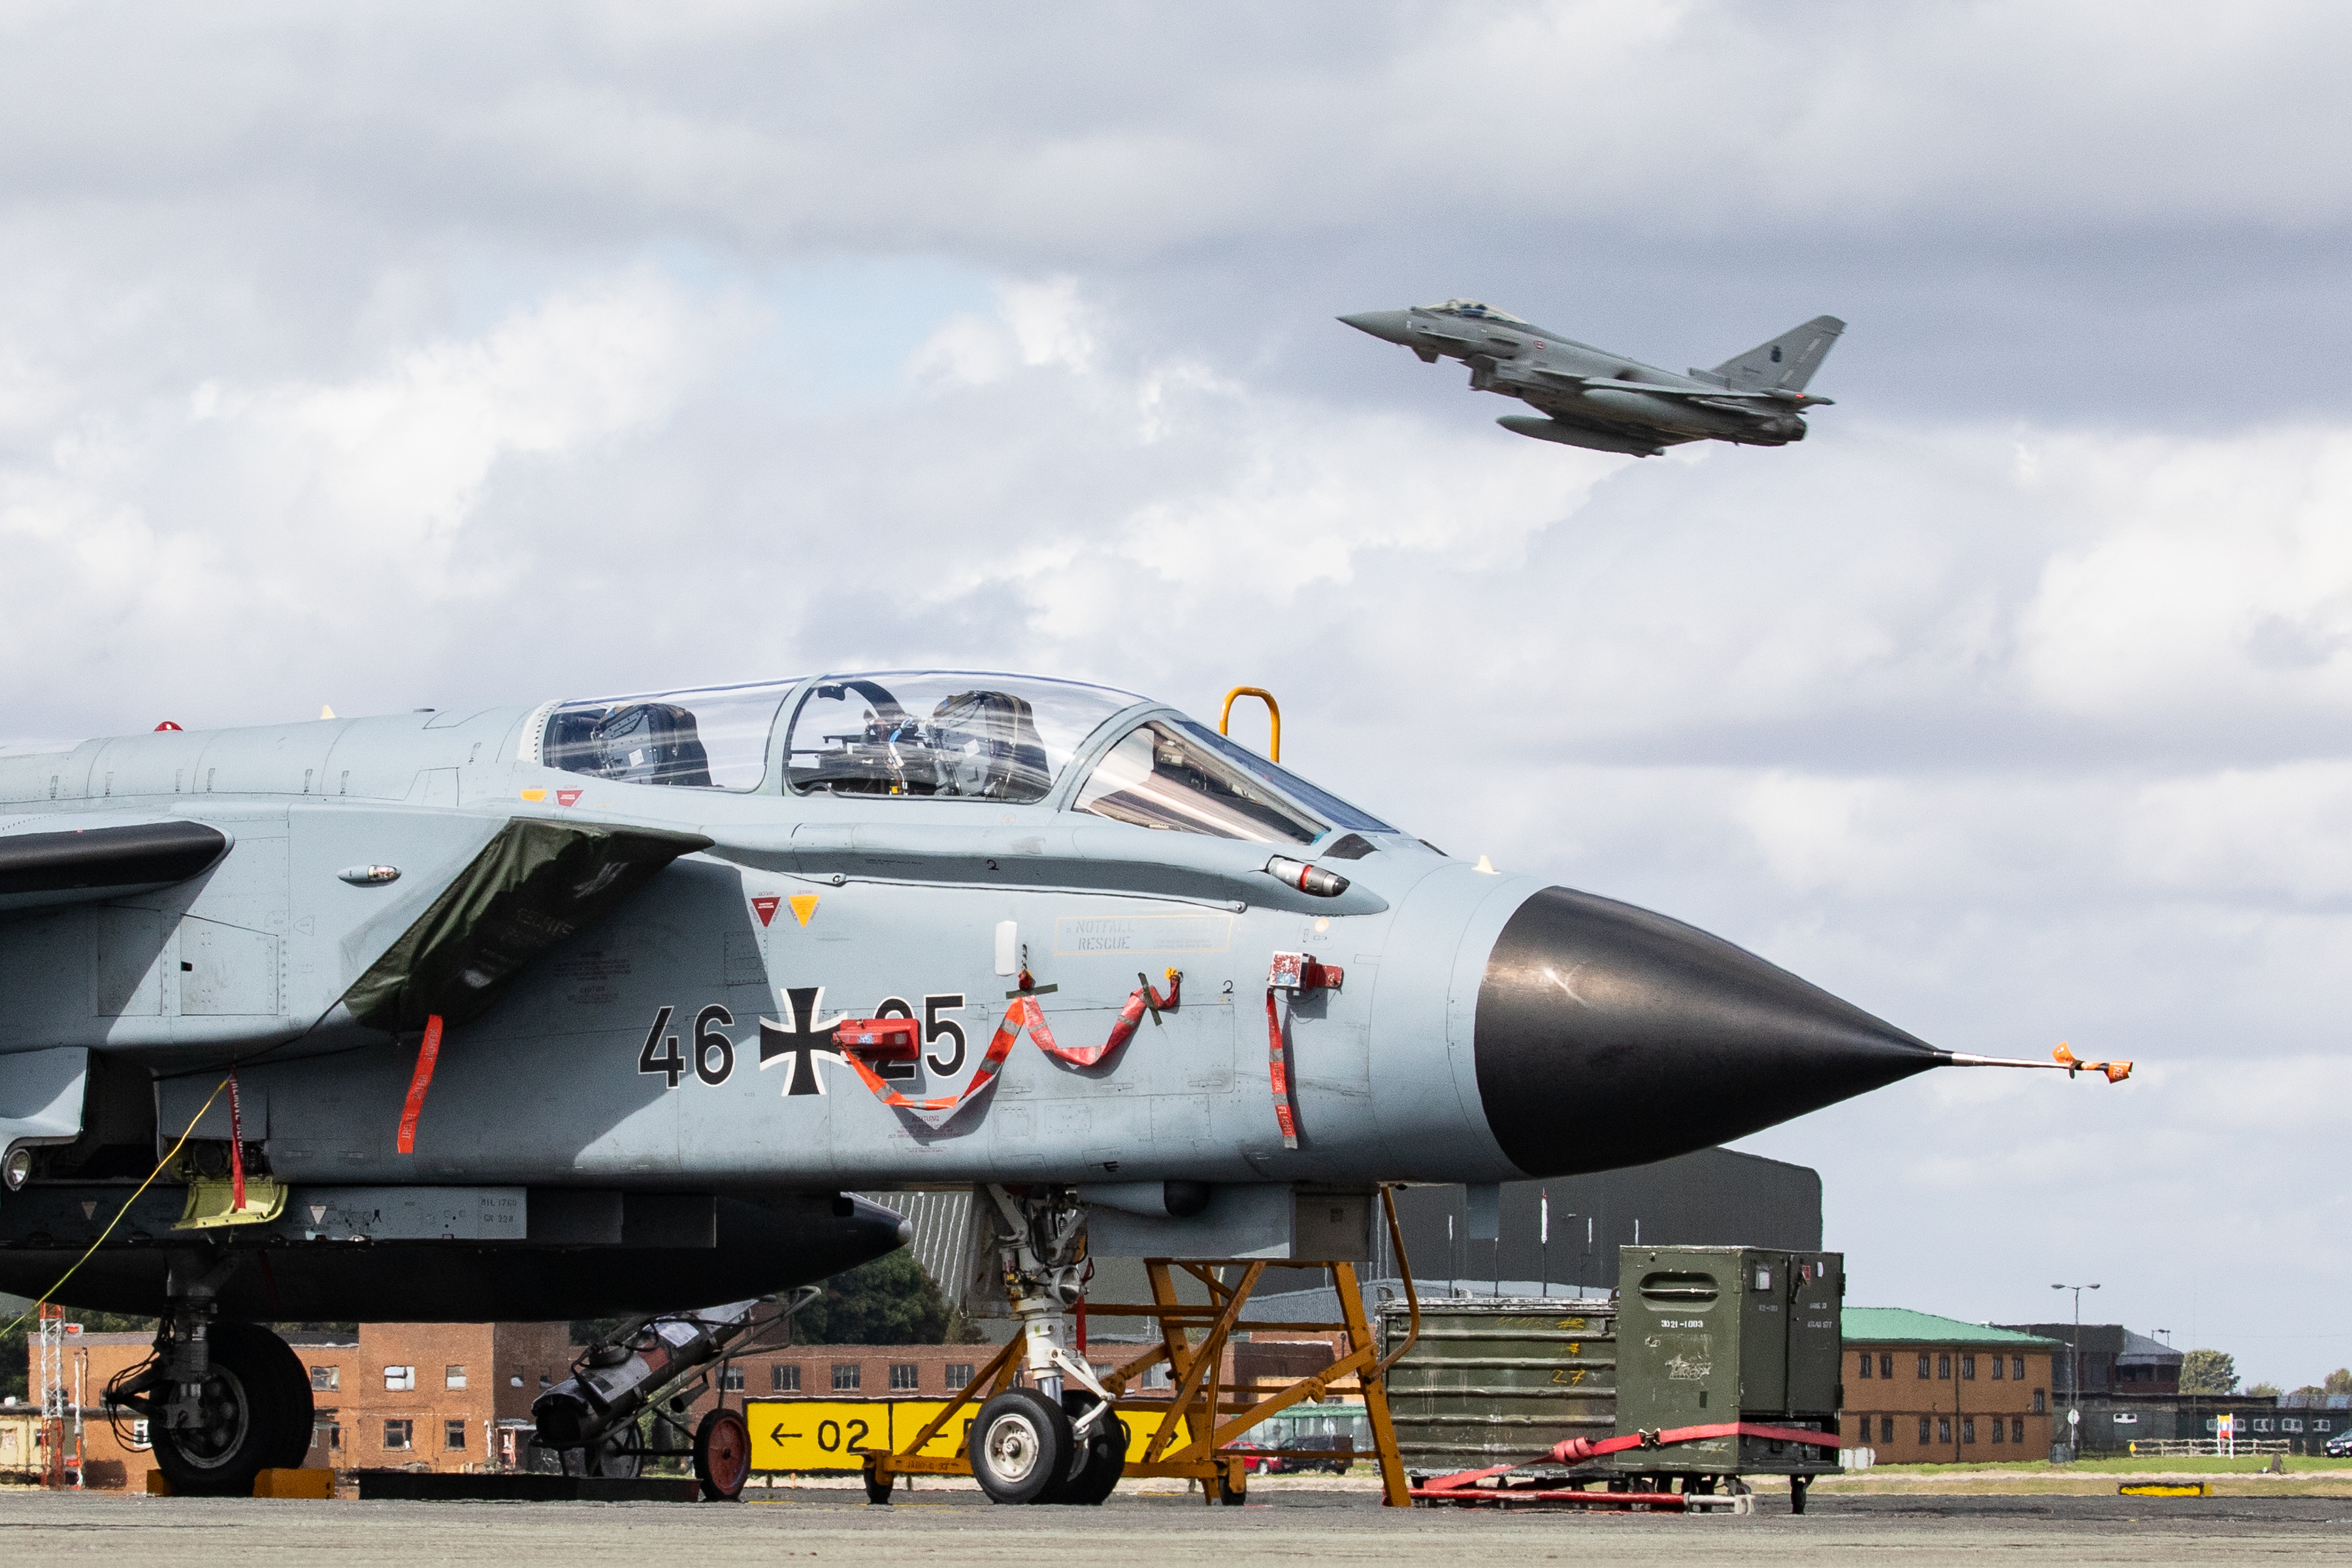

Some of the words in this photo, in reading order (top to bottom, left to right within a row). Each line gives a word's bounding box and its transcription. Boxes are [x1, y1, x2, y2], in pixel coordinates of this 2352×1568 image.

[1075, 920, 1135, 934] NOTFALL
[1078, 936, 1131, 951] RESCUE
[638, 1003, 735, 1089] 46
[401, 1113, 417, 1140] FLIGHT
[1277, 1105, 1292, 1135] FLIGHT
[817, 1418, 870, 1453] 02
